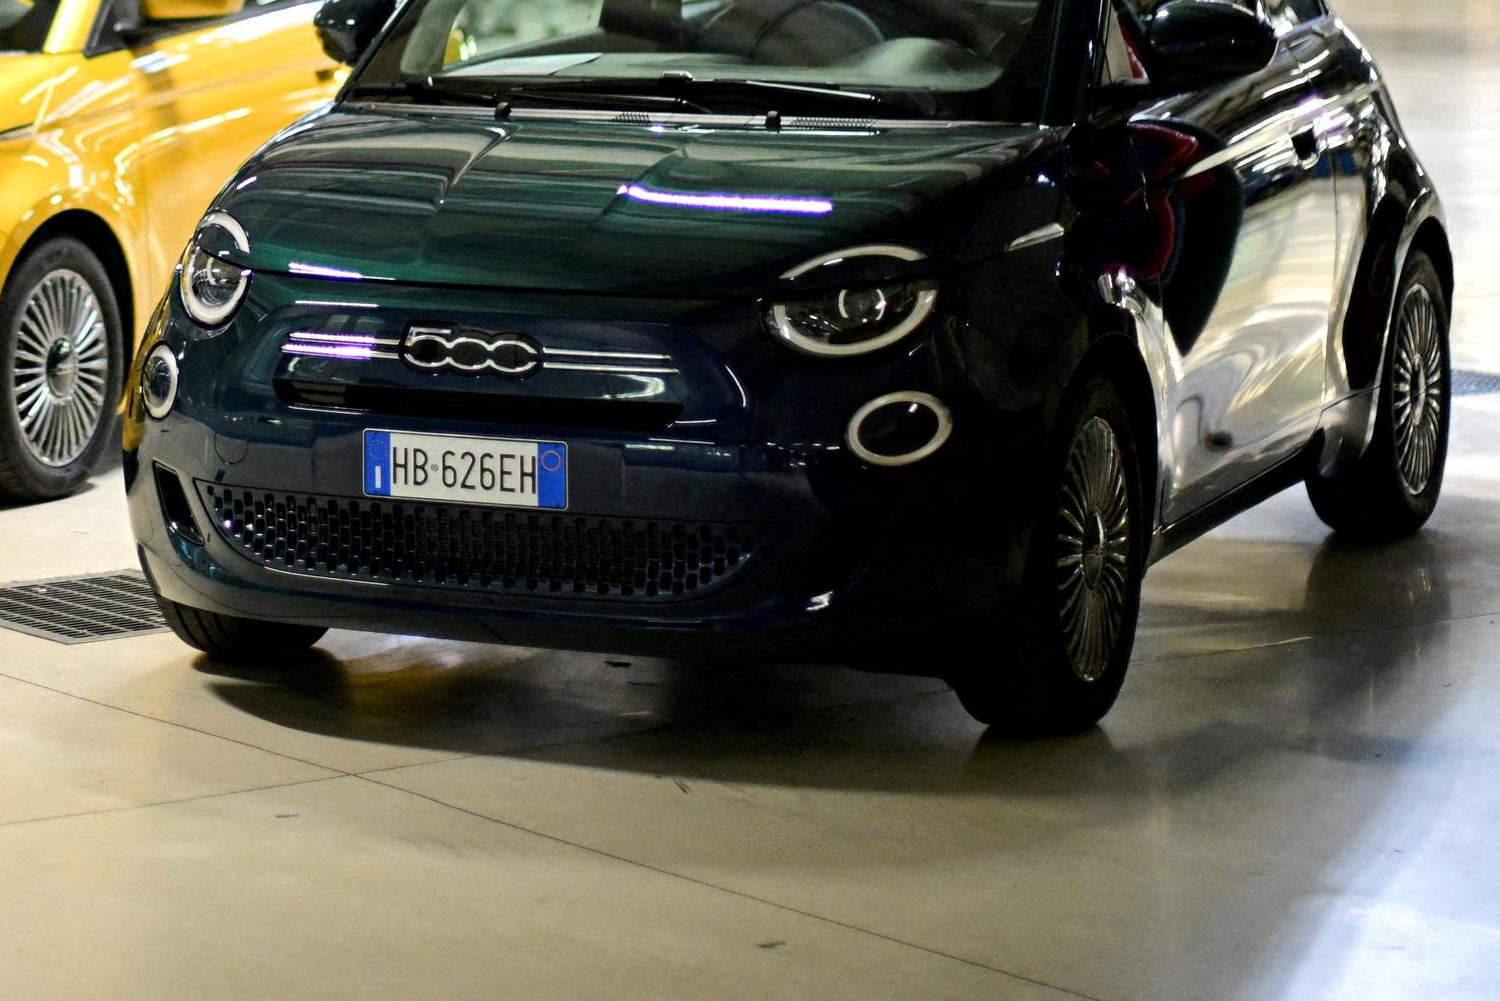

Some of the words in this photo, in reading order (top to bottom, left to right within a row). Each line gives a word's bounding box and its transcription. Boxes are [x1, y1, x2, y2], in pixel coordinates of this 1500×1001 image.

[404, 326, 538, 373] 500
[392, 446, 428, 487] HB
[442, 450, 536, 494] 626EH
